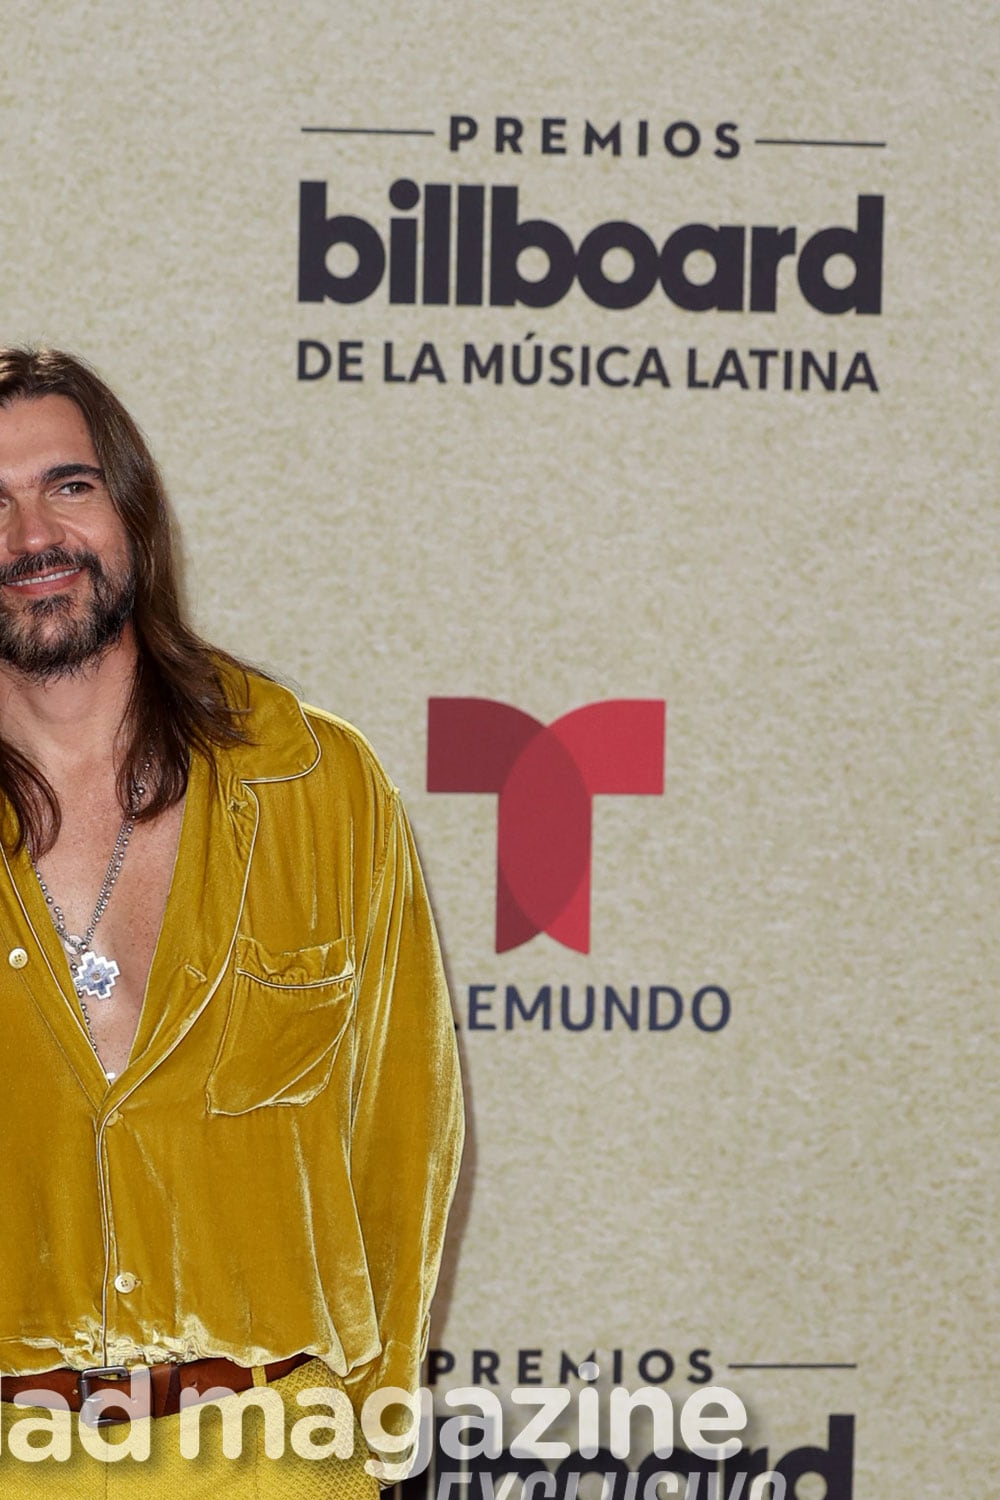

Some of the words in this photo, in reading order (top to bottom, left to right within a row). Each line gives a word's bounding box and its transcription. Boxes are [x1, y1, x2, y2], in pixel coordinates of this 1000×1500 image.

[449, 115, 740, 159] PREMIOS
[298, 178, 886, 315] billboard
[297, 340, 364, 382] DE
[383, 342, 446, 383] LA
[463, 332, 671, 389] MÚSICA
[687, 348, 880, 393] LATINA
[455, 984, 732, 1033] EMUNDO
[427, 1349, 714, 1385] PREMIOS
